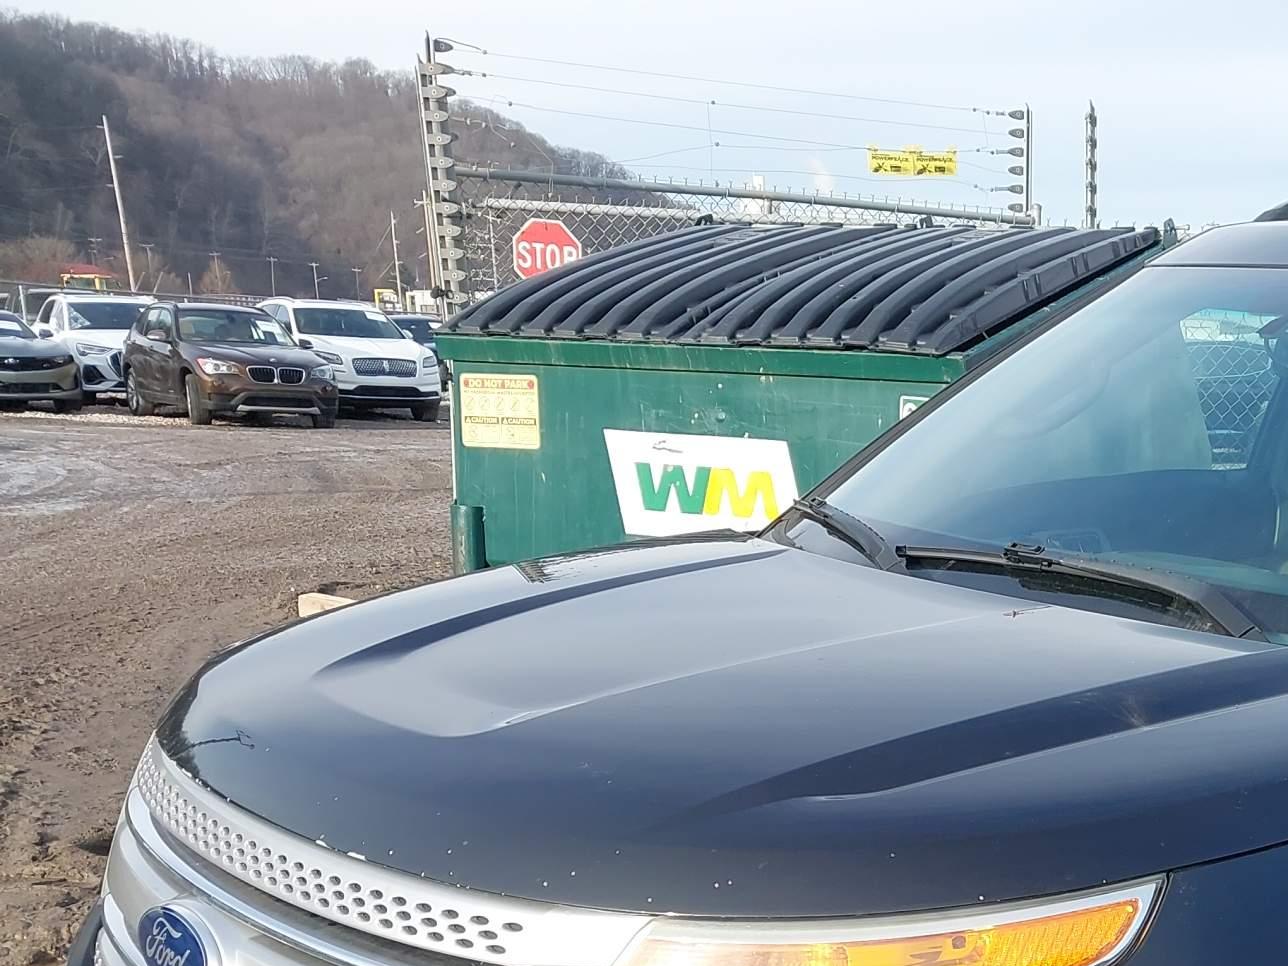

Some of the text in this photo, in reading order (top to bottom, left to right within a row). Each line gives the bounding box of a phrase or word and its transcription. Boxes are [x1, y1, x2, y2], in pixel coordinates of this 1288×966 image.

[518, 241, 577, 269] STOP
[469, 379, 528, 390] DO NOT PARK
[471, 416, 498, 424] CAUTION
[508, 417, 535, 425] CAUTION
[634, 462, 779, 520] WM
